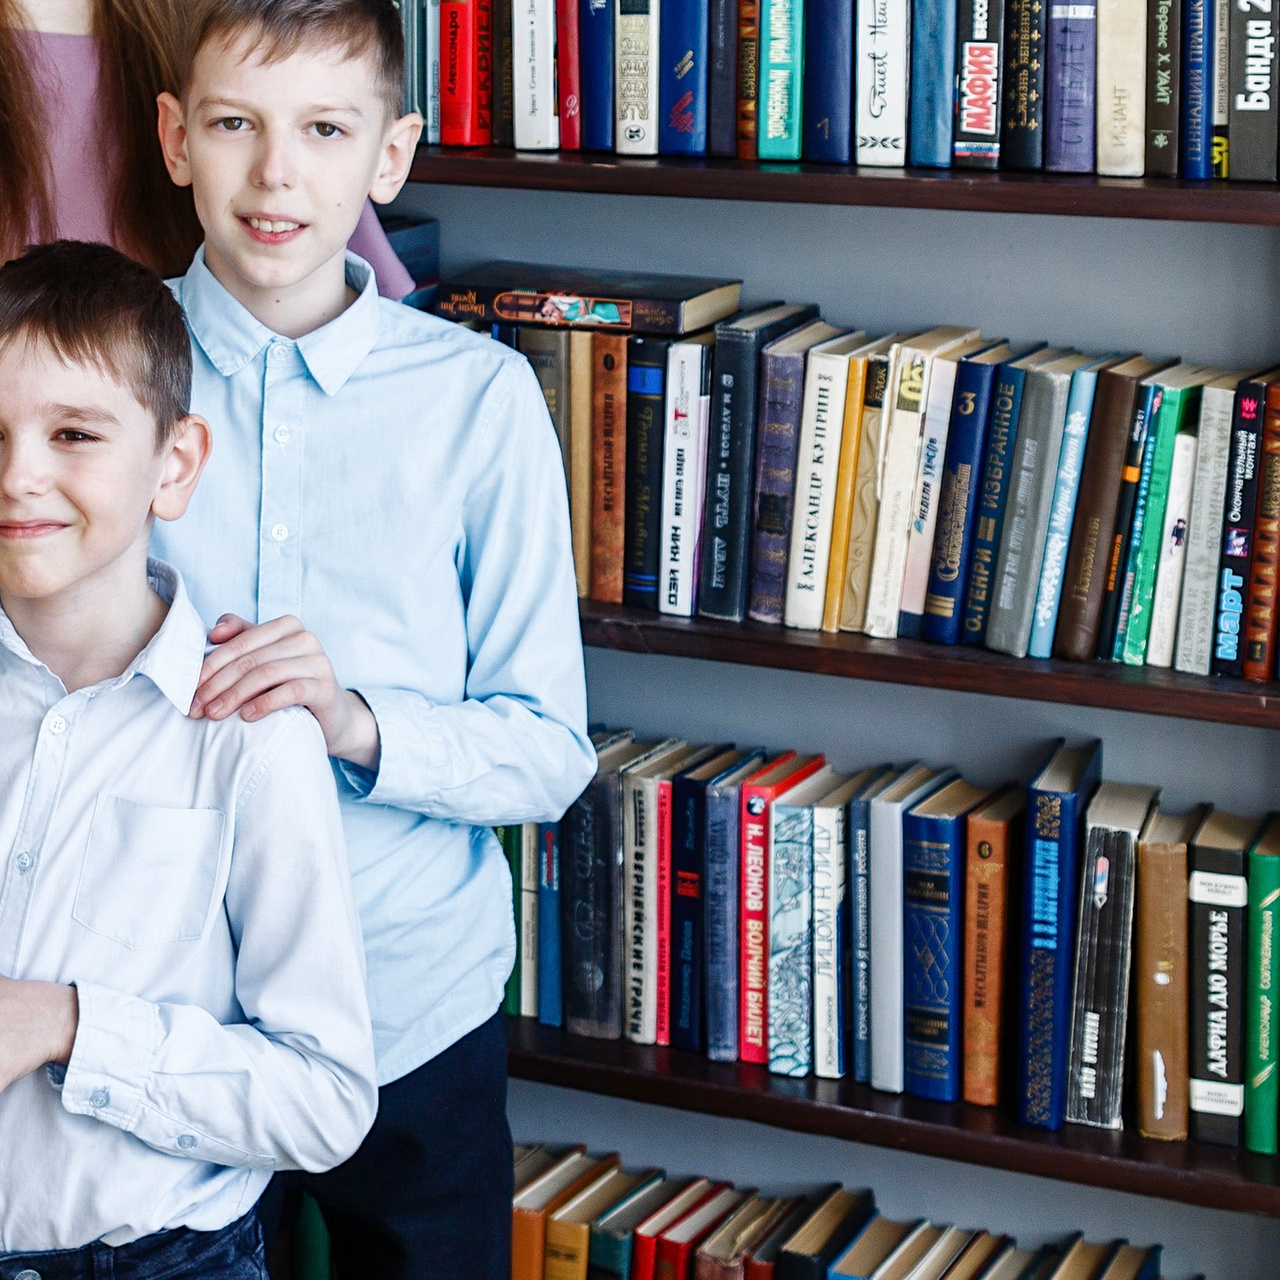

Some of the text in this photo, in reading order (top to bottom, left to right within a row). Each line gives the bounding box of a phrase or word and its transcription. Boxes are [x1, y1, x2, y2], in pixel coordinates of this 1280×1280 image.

[448, 10, 460, 95] Александра
[1159, 0, 1172, 48] Теренс
[866, 50, 890, 118] Ernest
[963, 44, 995, 130] МАФИЯ
[1018, 69, 1028, 114] ЖИЗНЬ
[1156, 69, 1170, 104] УАЙТ
[1235, 19, 1272, 111] Банда
[767, 70, 790, 138] ЗАРУБЕЖНЫЙ
[1187, 69, 1203, 161] ГЕННАДИЙ
[875, 367, 886, 402] БЛОК
[801, 386, 829, 578] АЛЕКСАНДР КУПРИН
[1053, 438, 1080, 530] Морис Дрюон
[1230, 430, 1247, 522] Окончательный
[1245, 432, 1256, 479] монтаж
[716, 473, 729, 528] ПУТЬ
[1206, 446, 1227, 550] МЕЛЬНИКОВ
[668, 526, 681, 606] ДЭЙ КИН
[1183, 602, 1197, 663] ПОВЕСТИ
[1196, 590, 1210, 665] РАССКАЗЫ
[1216, 568, 1243, 660] март
[750, 843, 764, 910] ЛЕОНОВ
[816, 824, 832, 978] ЛИЦОМ К ЛИЦУ
[631, 854, 647, 1034] ВЕРНЕЙСКИЕ ГРАЧИ
[748, 920, 765, 989] ВОЛЧИЙ
[1209, 911, 1228, 970] МОРЬЕ
[746, 992, 762, 1046] БИЛЕТ
[1209, 974, 1228, 1007] ДЮ
[1208, 1010, 1228, 1077] ДАФНА
